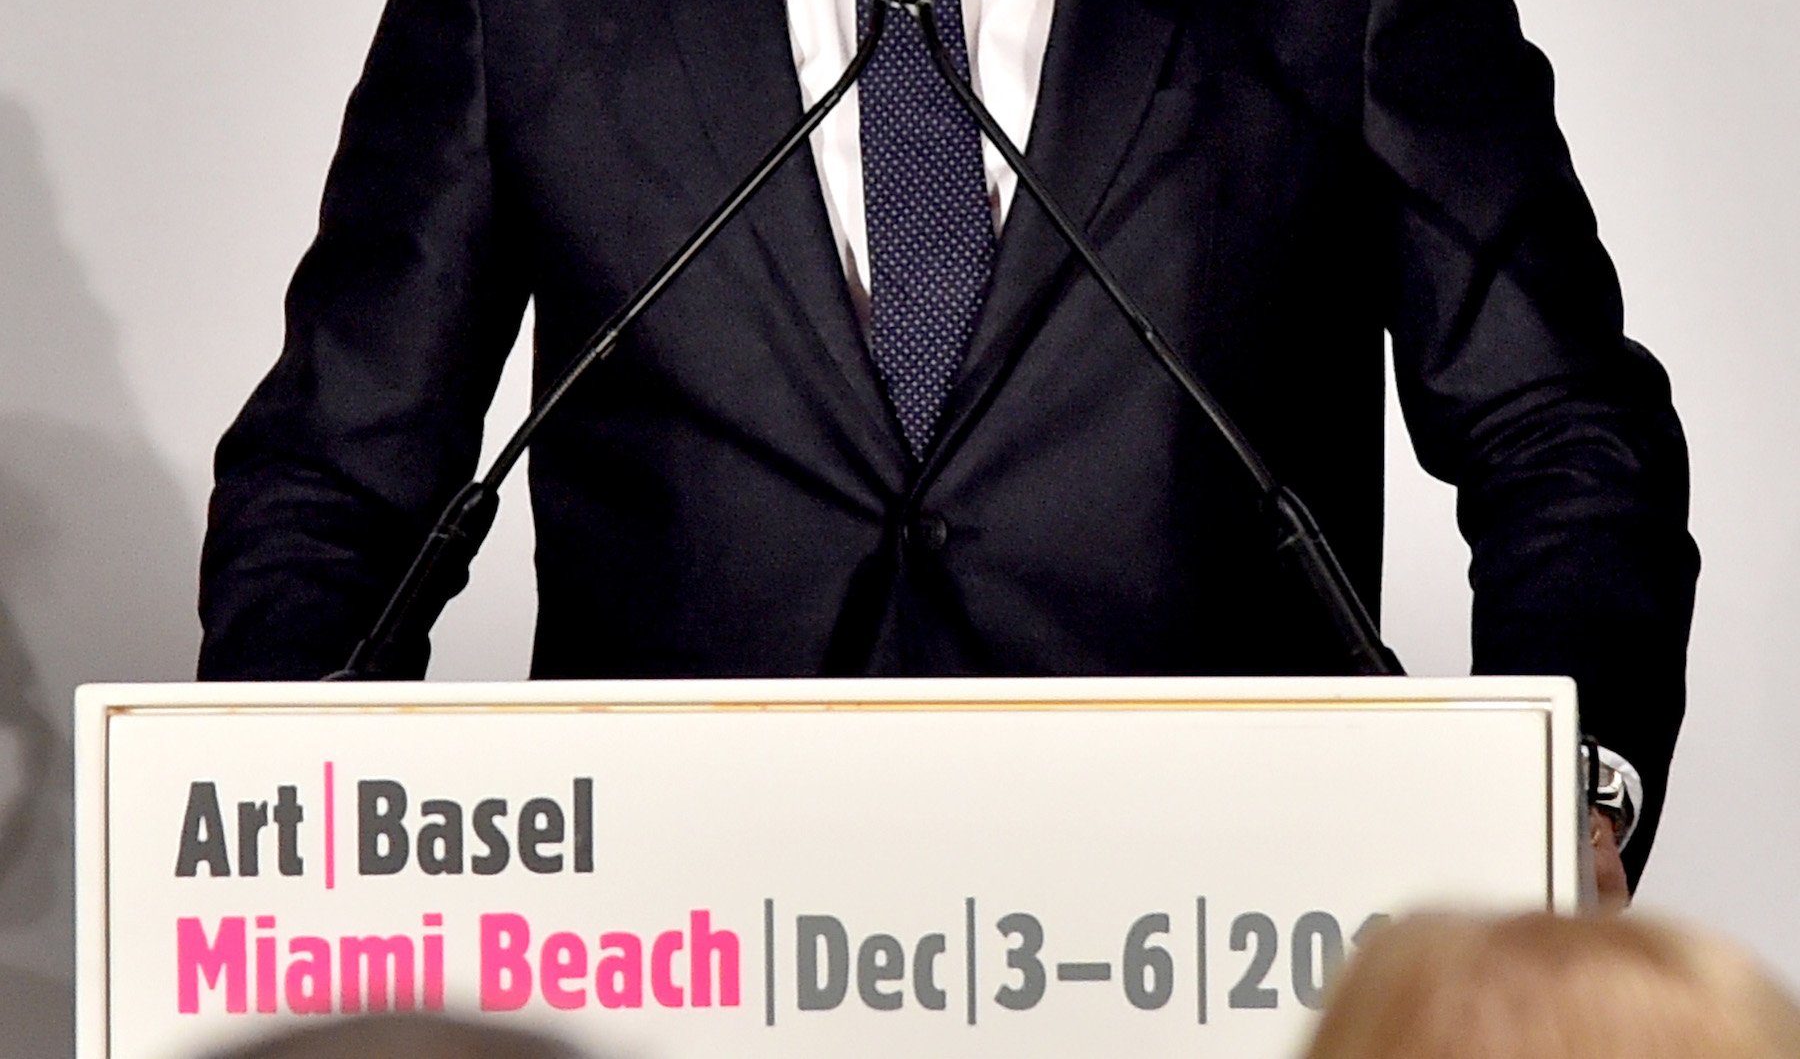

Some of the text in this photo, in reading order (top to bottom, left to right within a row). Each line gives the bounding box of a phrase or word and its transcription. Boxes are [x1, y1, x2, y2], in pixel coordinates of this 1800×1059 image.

[175, 777, 594, 877] Art Basel
[176, 913, 445, 1014] Miami
[480, 909, 741, 1010] Beach
[796, 915, 946, 1010] Dec
